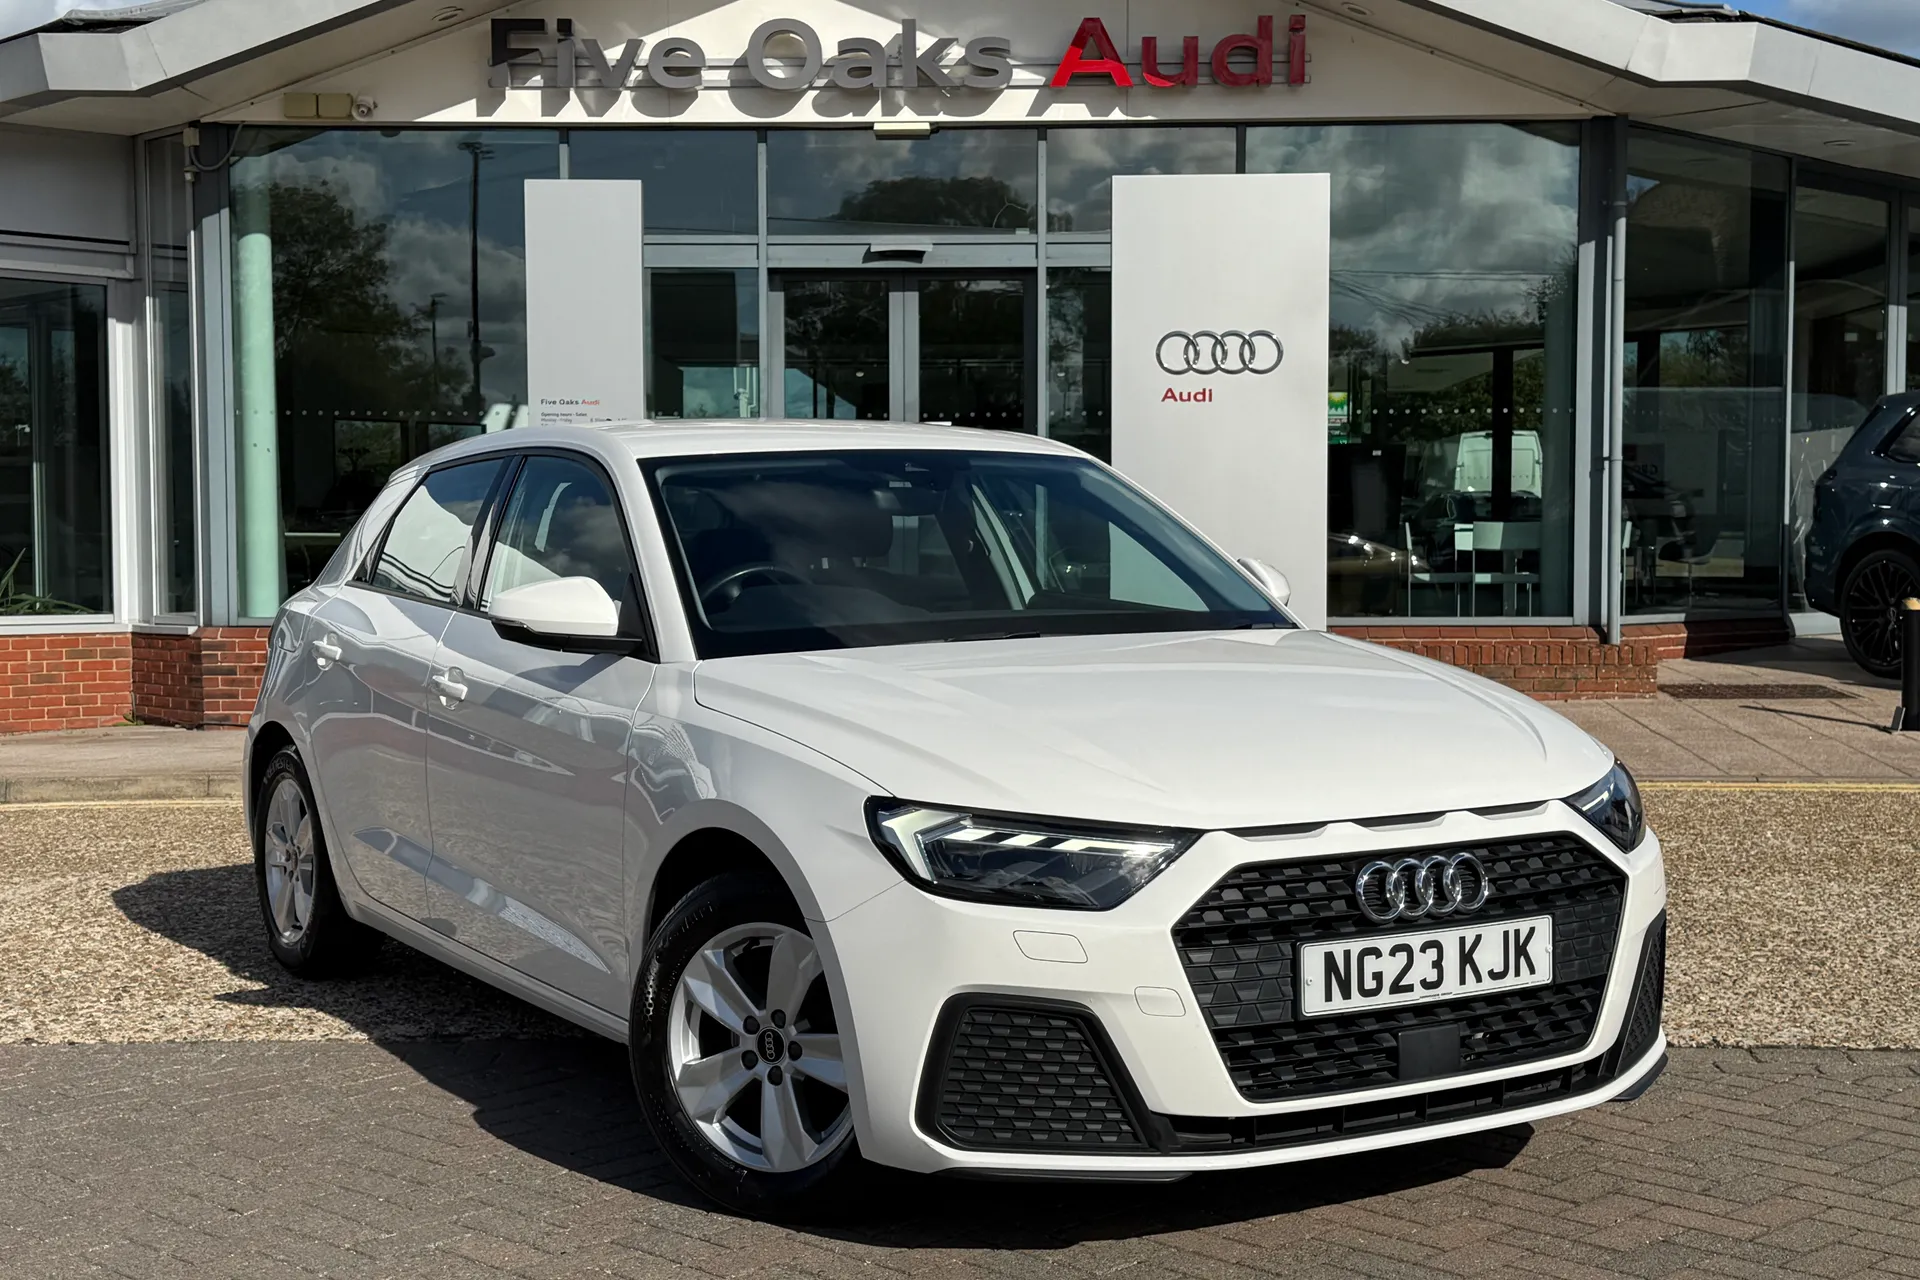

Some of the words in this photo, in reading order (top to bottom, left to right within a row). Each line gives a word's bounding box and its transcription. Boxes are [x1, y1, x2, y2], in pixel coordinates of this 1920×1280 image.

[490, 18, 706, 89] Five
[747, 18, 1013, 90] Oaks
[1050, 14, 1307, 88] Audi
[1161, 387, 1213, 402] Audi
[1324, 940, 1444, 1003] NG23
[1458, 926, 1536, 986] KJK
